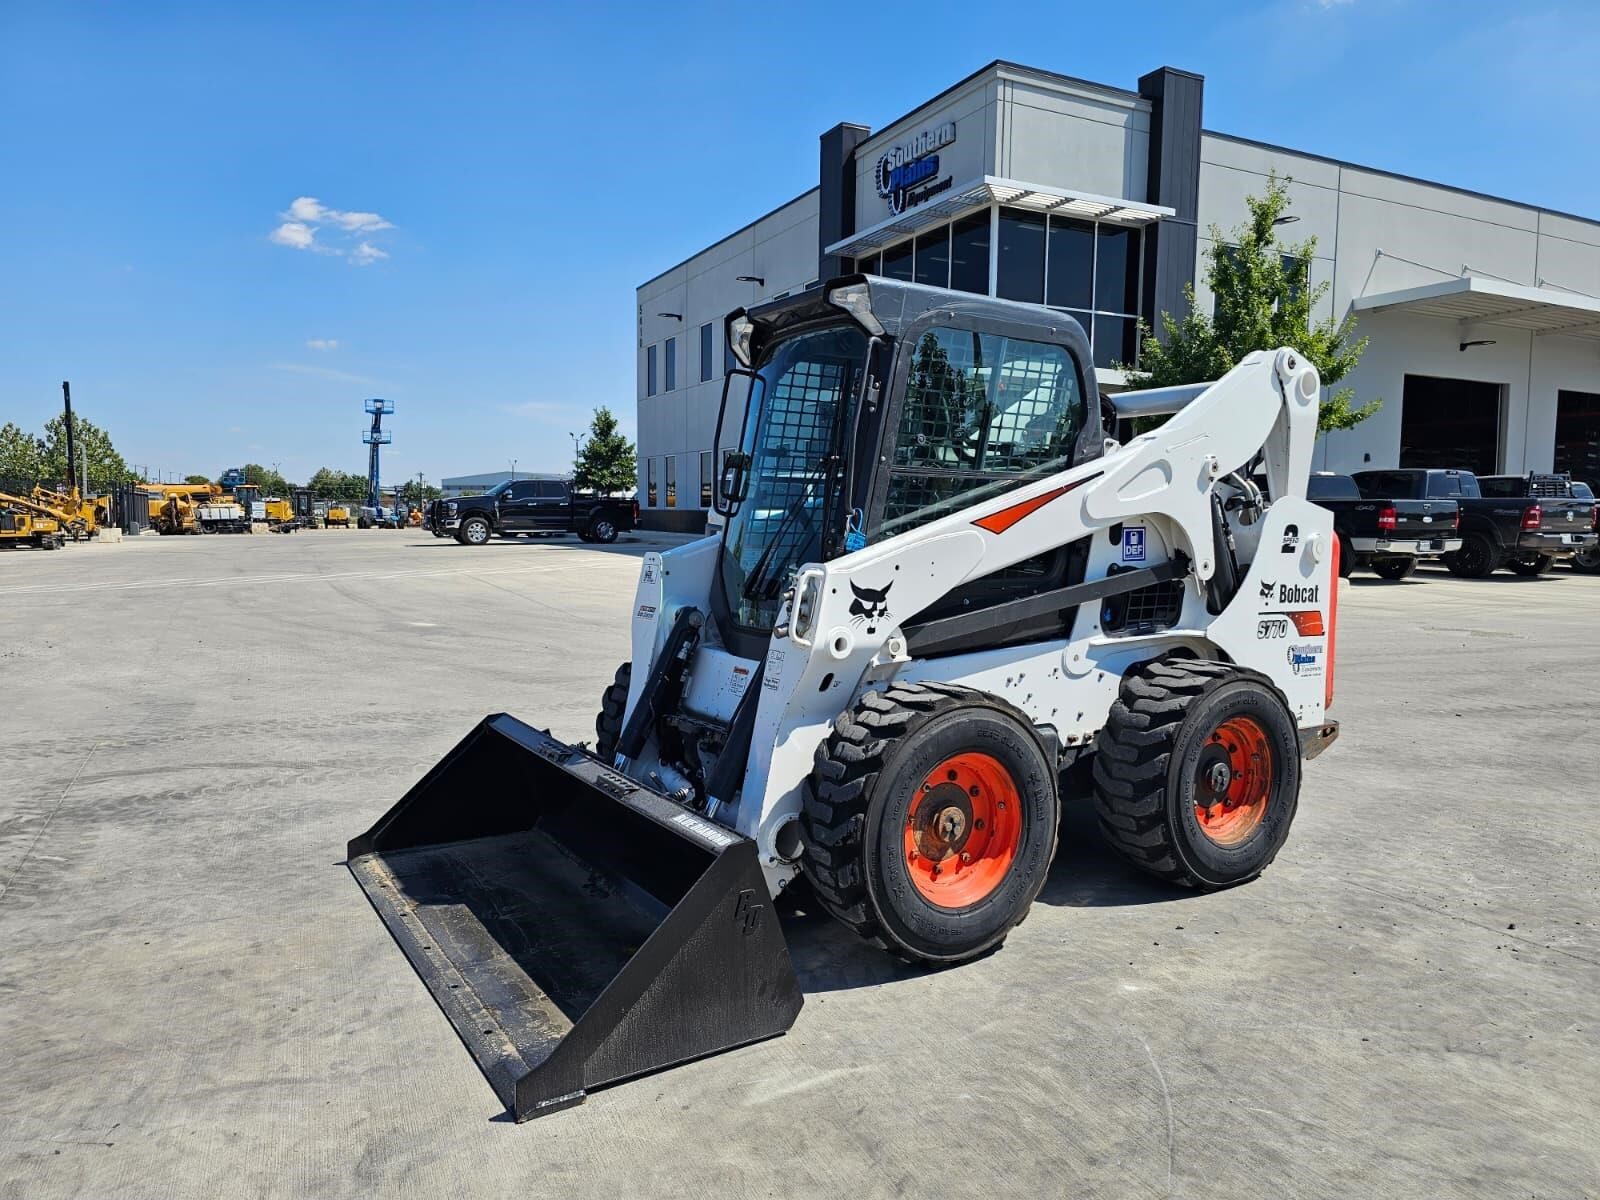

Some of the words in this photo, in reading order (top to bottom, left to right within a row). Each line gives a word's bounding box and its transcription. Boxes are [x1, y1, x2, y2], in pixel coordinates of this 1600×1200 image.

[887, 123, 956, 171] Southern
[1281, 524, 1298, 553] 2
[1125, 545, 1143, 555] DEF
[1279, 584, 1319, 604] Bobcat
[1257, 619, 1288, 639] S770
